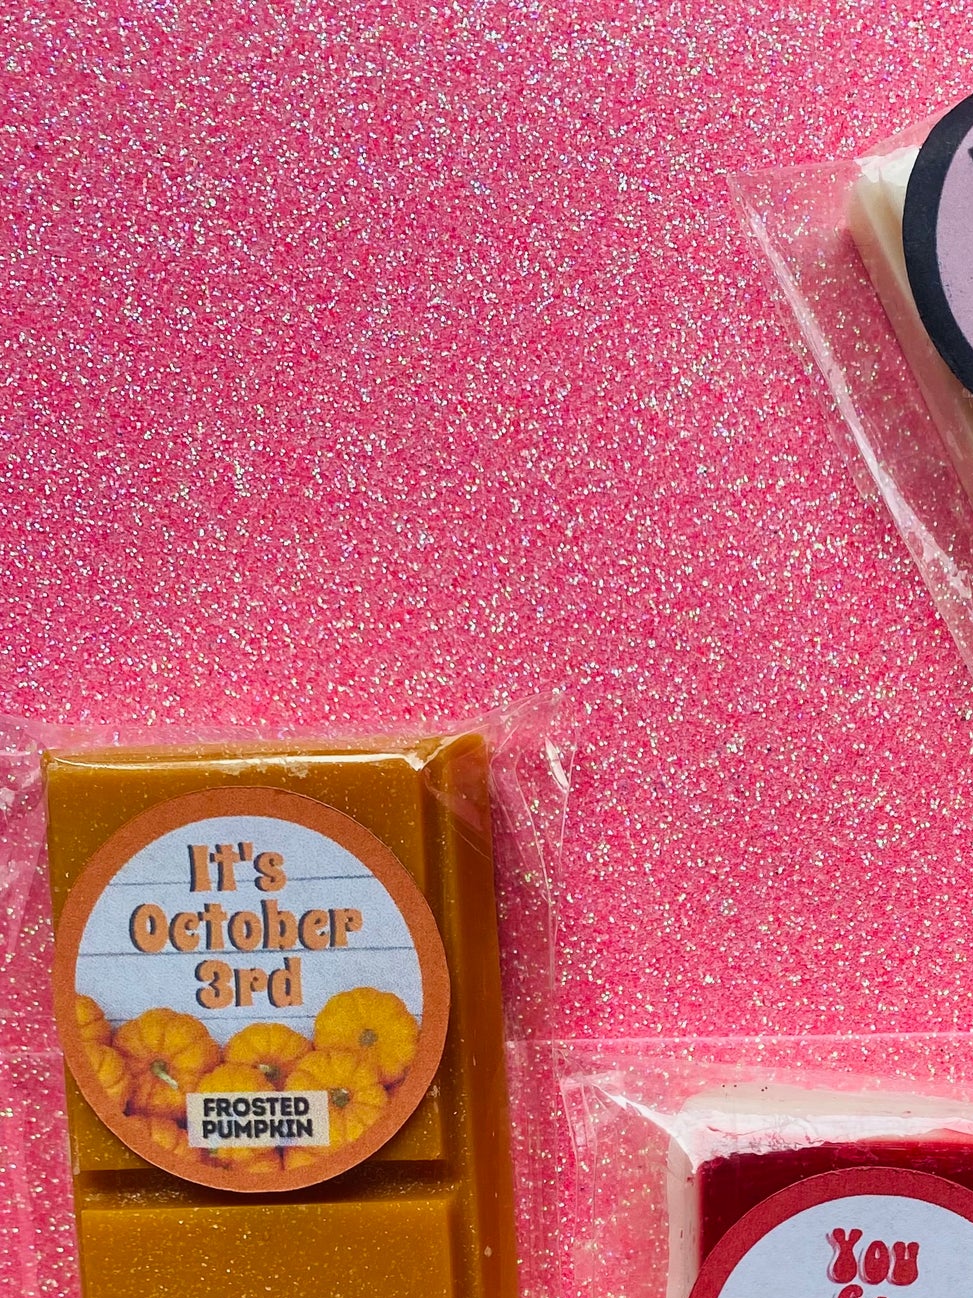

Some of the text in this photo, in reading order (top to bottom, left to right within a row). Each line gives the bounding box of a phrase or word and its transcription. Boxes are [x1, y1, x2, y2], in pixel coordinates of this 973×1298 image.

[187, 841, 287, 893] It's
[129, 899, 364, 954] October
[195, 957, 304, 1010] 3rd
[202, 1096, 311, 1118] FROSTED
[202, 1118, 314, 1139] PUMPKIN
[826, 1228, 920, 1286] You
